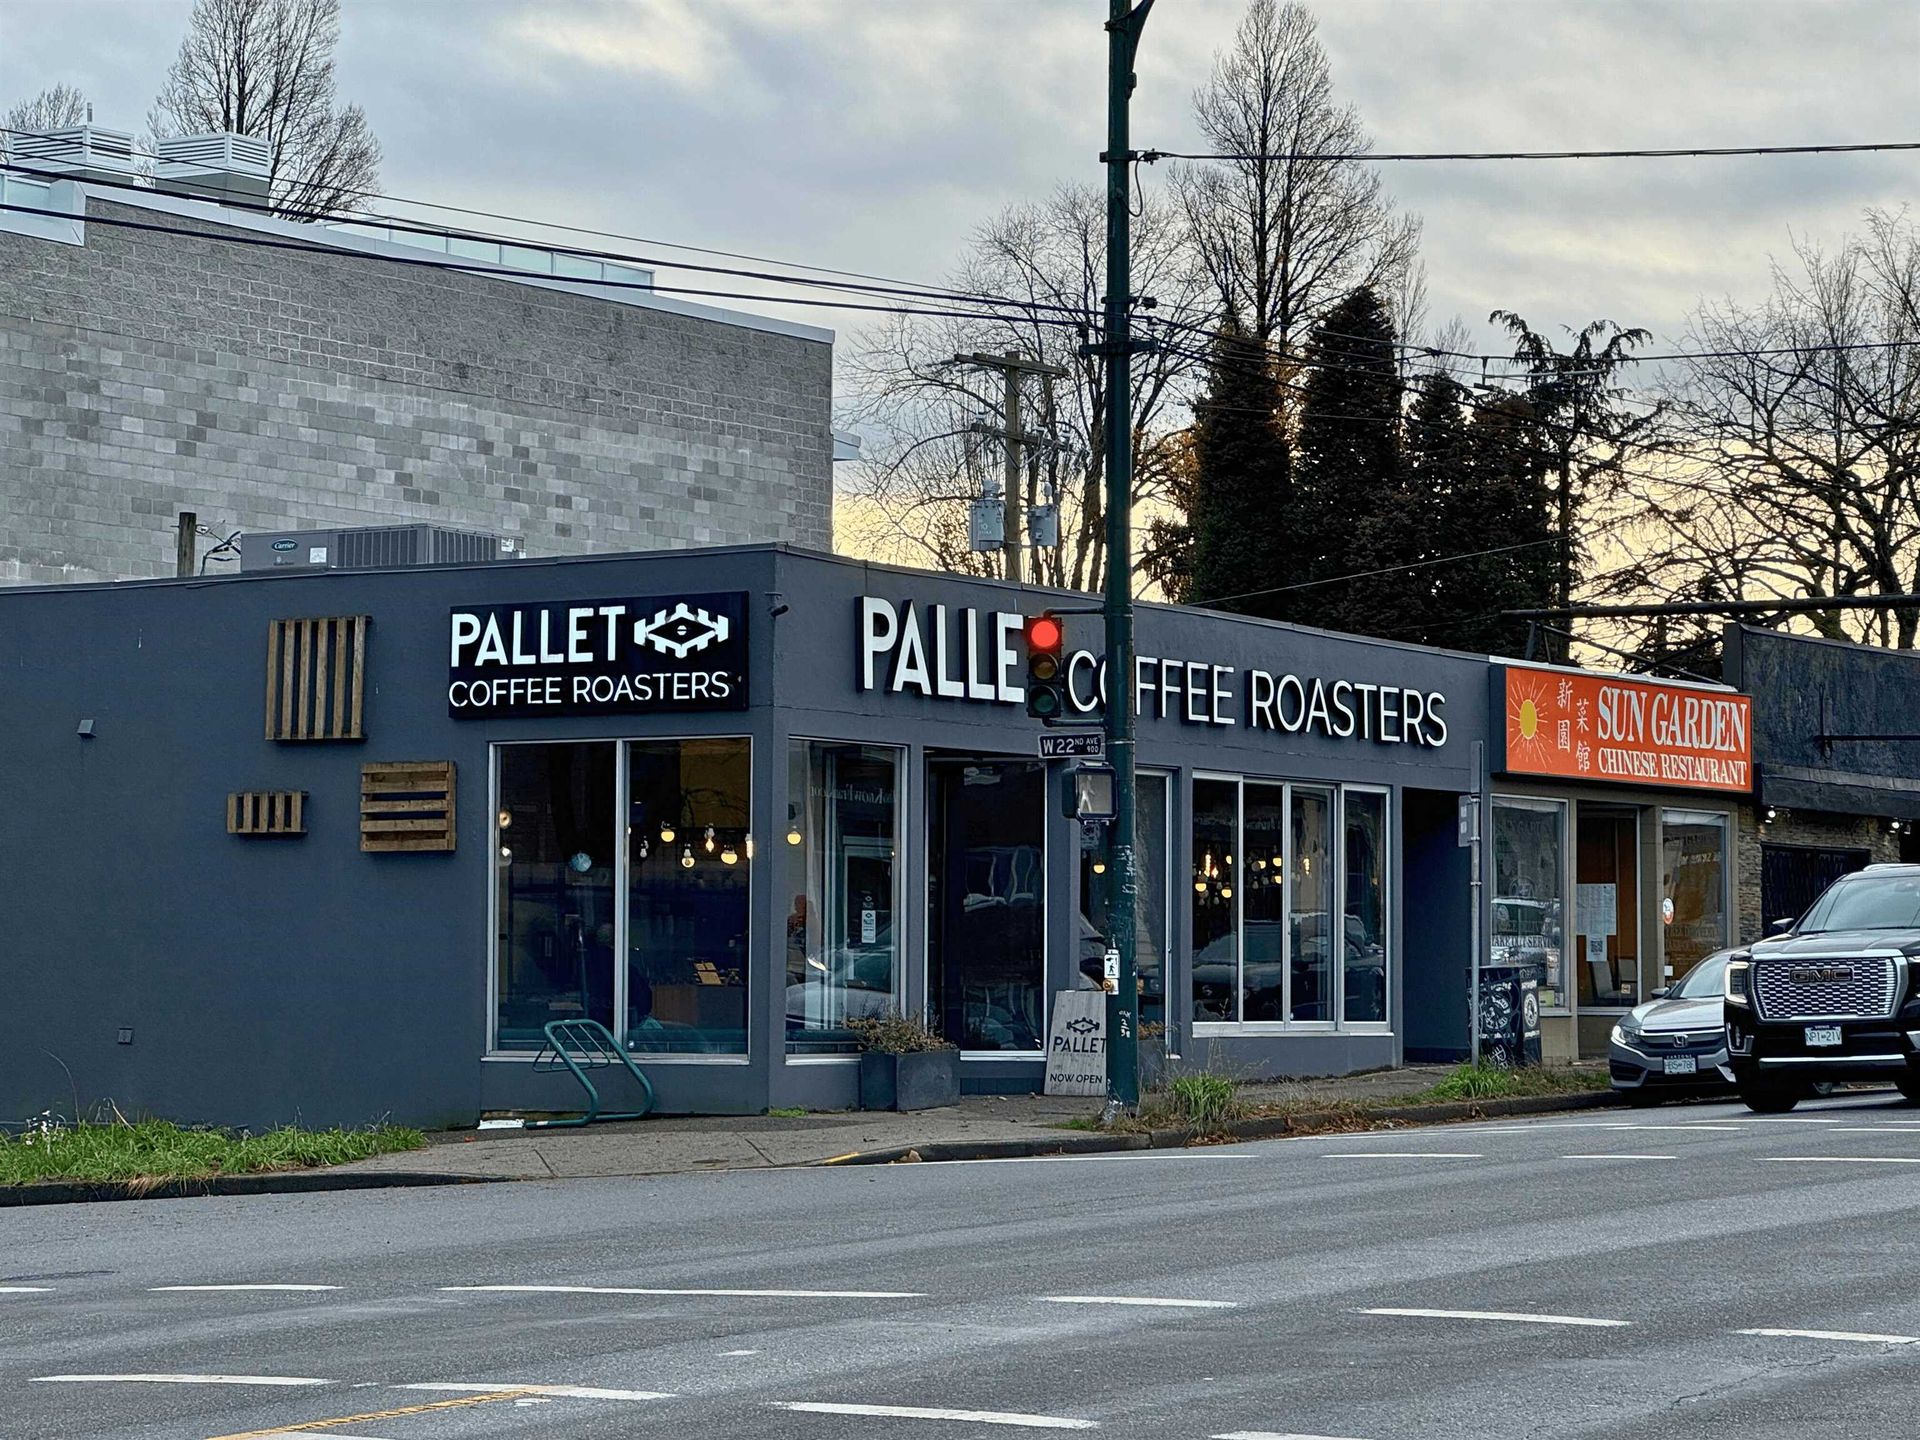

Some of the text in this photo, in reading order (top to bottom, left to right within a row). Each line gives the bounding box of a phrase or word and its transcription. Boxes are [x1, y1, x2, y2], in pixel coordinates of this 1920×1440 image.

[274, 541, 296, 549] Carrier
[451, 605, 626, 667] PALLET
[863, 596, 1447, 747] PALLE CFFEE ROASTERS
[449, 671, 729, 707] COFFEE ROASTERS
[1598, 686, 1748, 753] SUN GARDEN
[1043, 740, 1054, 754] W
[1598, 747, 1747, 785] CHINESE RESTAURANT
[1791, 968, 1851, 983] GMC
[1053, 1036, 1107, 1053] PALLET
[1050, 1073, 1103, 1083] NOW OPEN
